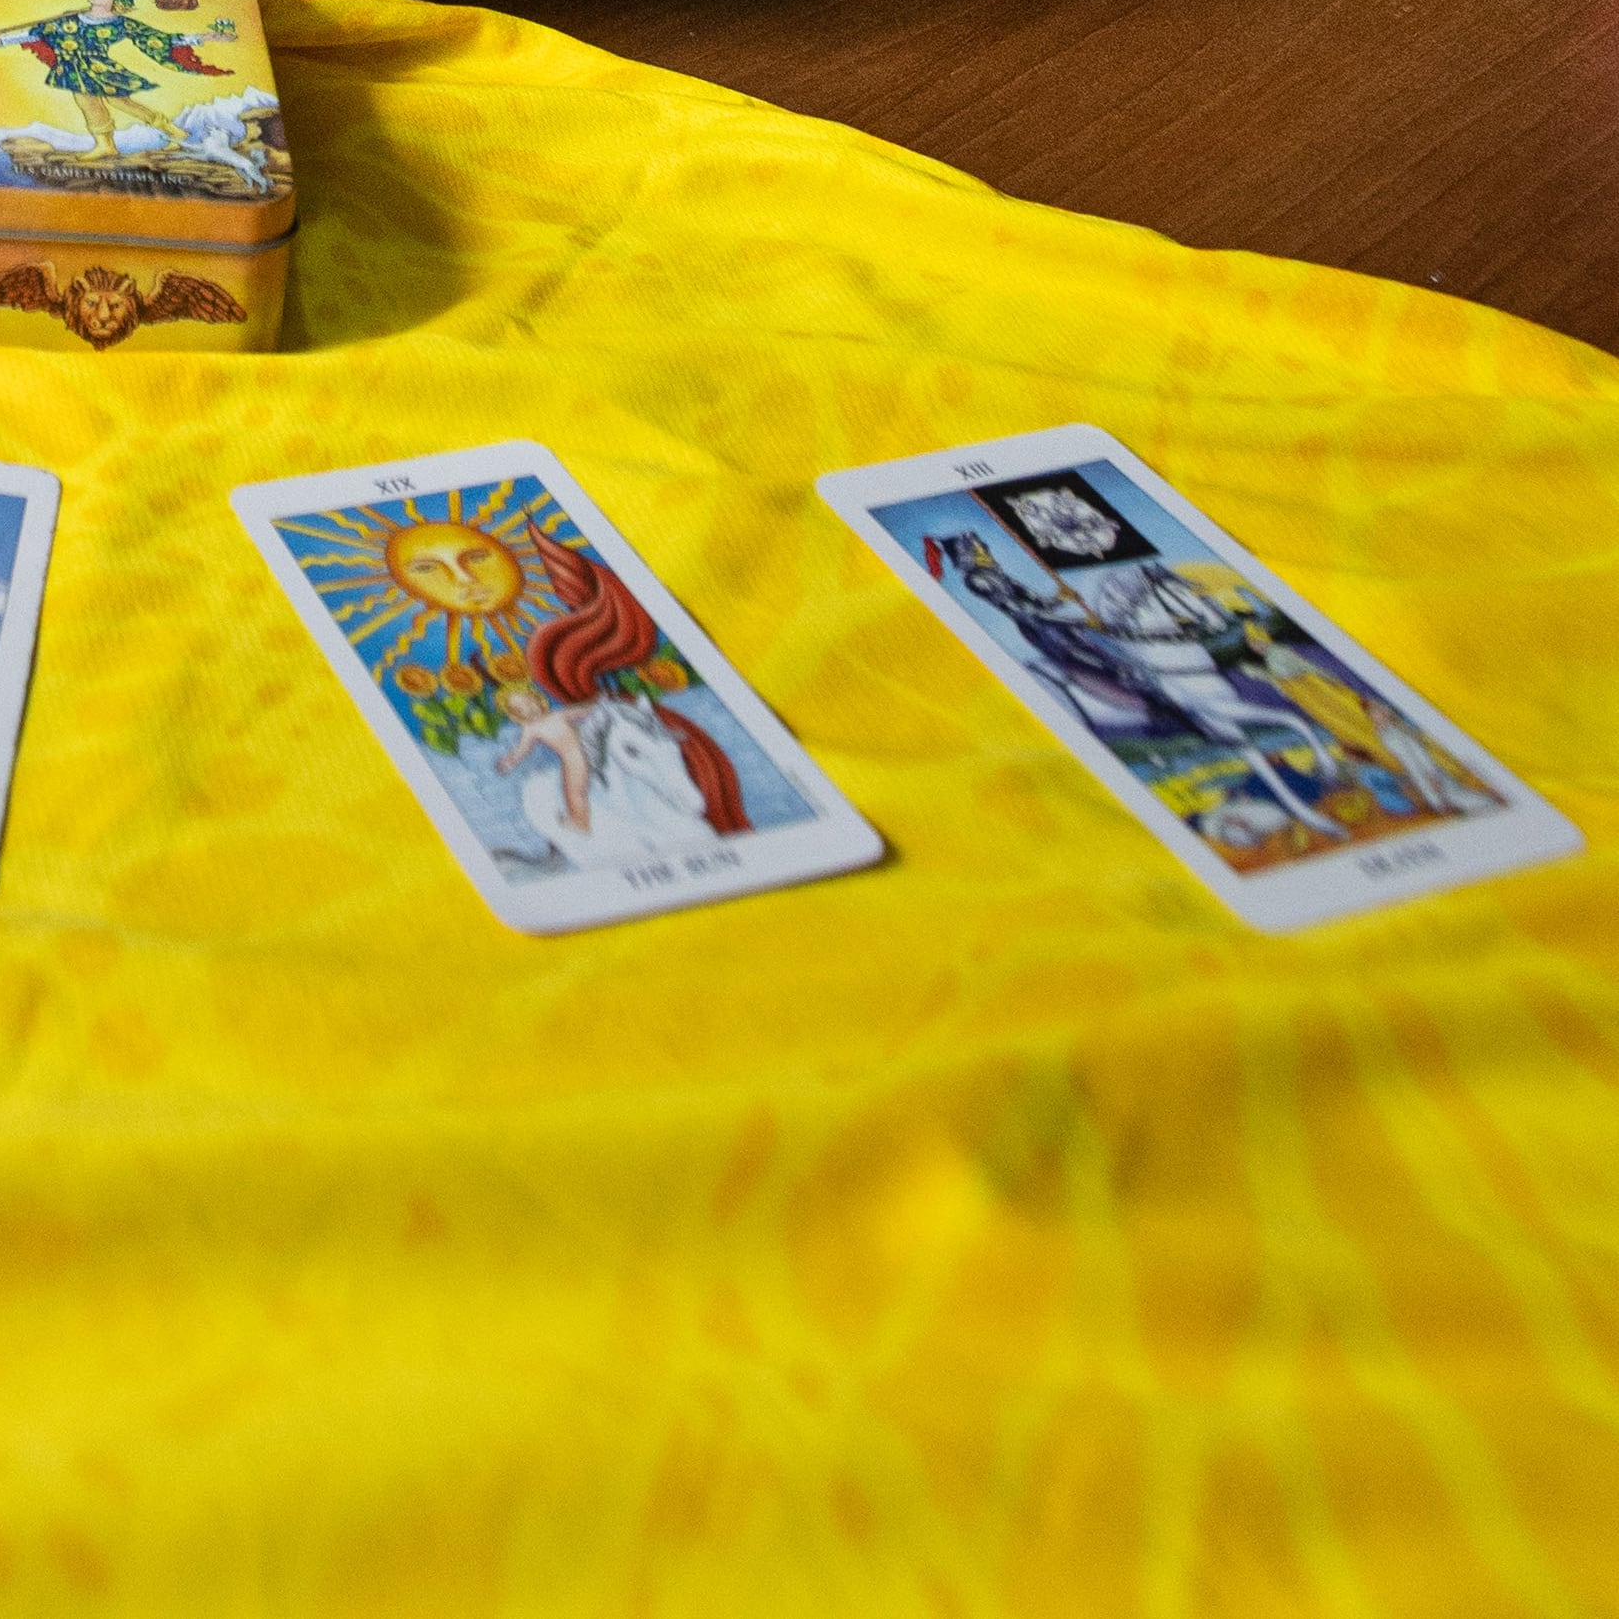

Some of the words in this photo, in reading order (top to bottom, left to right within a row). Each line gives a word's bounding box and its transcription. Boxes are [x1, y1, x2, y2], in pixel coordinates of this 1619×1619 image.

[41, 167, 91, 179] GAMES
[953, 459, 995, 482] XIII
[374, 475, 417, 497] XIX
